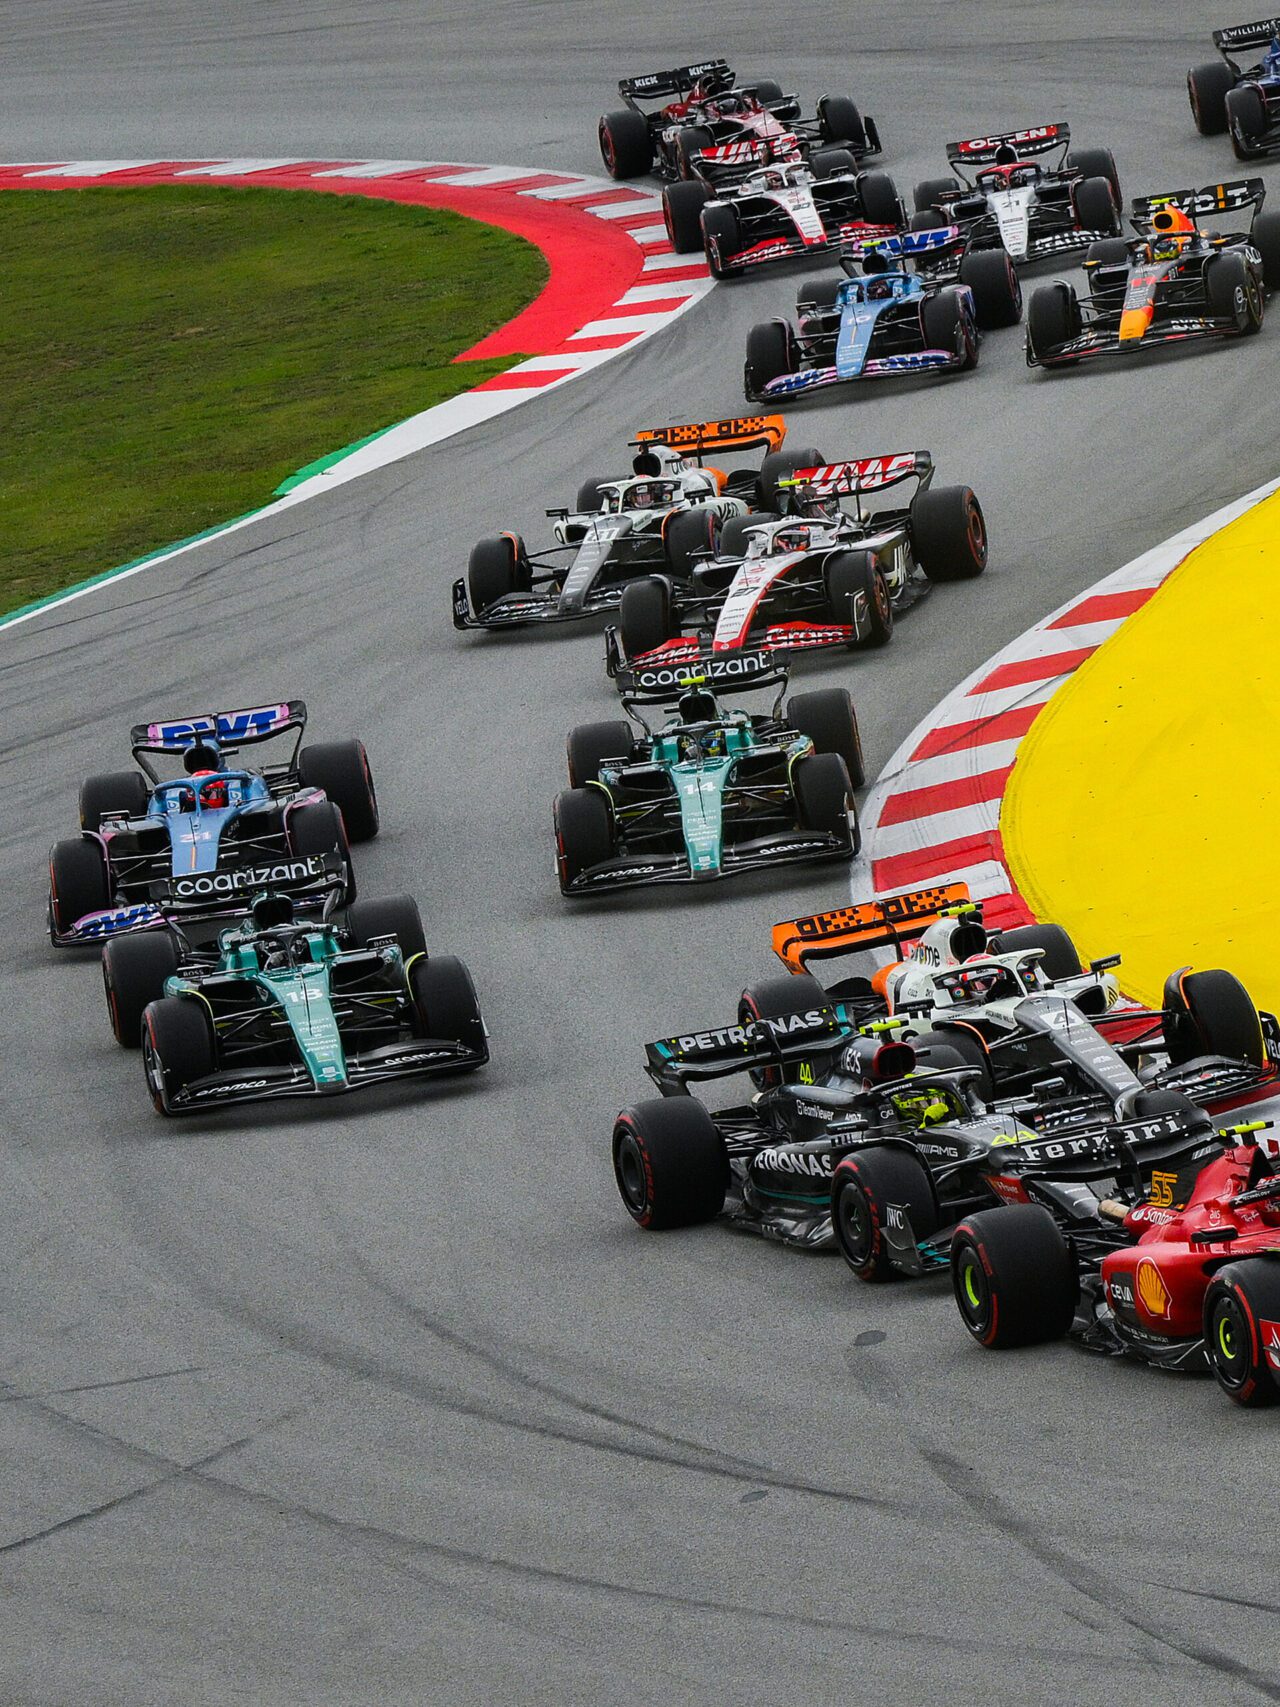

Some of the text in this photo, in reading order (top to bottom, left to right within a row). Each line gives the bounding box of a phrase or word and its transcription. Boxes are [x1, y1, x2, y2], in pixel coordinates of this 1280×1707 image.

[635, 75, 658, 87] KICK
[683, 782, 716, 795] 14
[759, 840, 825, 856] aramco
[176, 857, 321, 900] cognizant
[593, 864, 655, 881] aramco
[373, 936, 395, 947] BOSS
[182, 969, 205, 977] BOSS
[286, 988, 323, 1003] 18
[1053, 1011, 1077, 1025] 4
[678, 1009, 825, 1052] PETRONAS
[384, 1050, 452, 1066] aramco
[799, 1062, 814, 1085] 44
[196, 1079, 268, 1097] aramco
[991, 1130, 1038, 1146] 44
[1022, 1114, 1184, 1163] Ferrari
[929, 1144, 959, 1157] AMG
[753, 1149, 836, 1178] PETRONAS
[1147, 1170, 1178, 1208] 55
[886, 1206, 904, 1230] IWC
